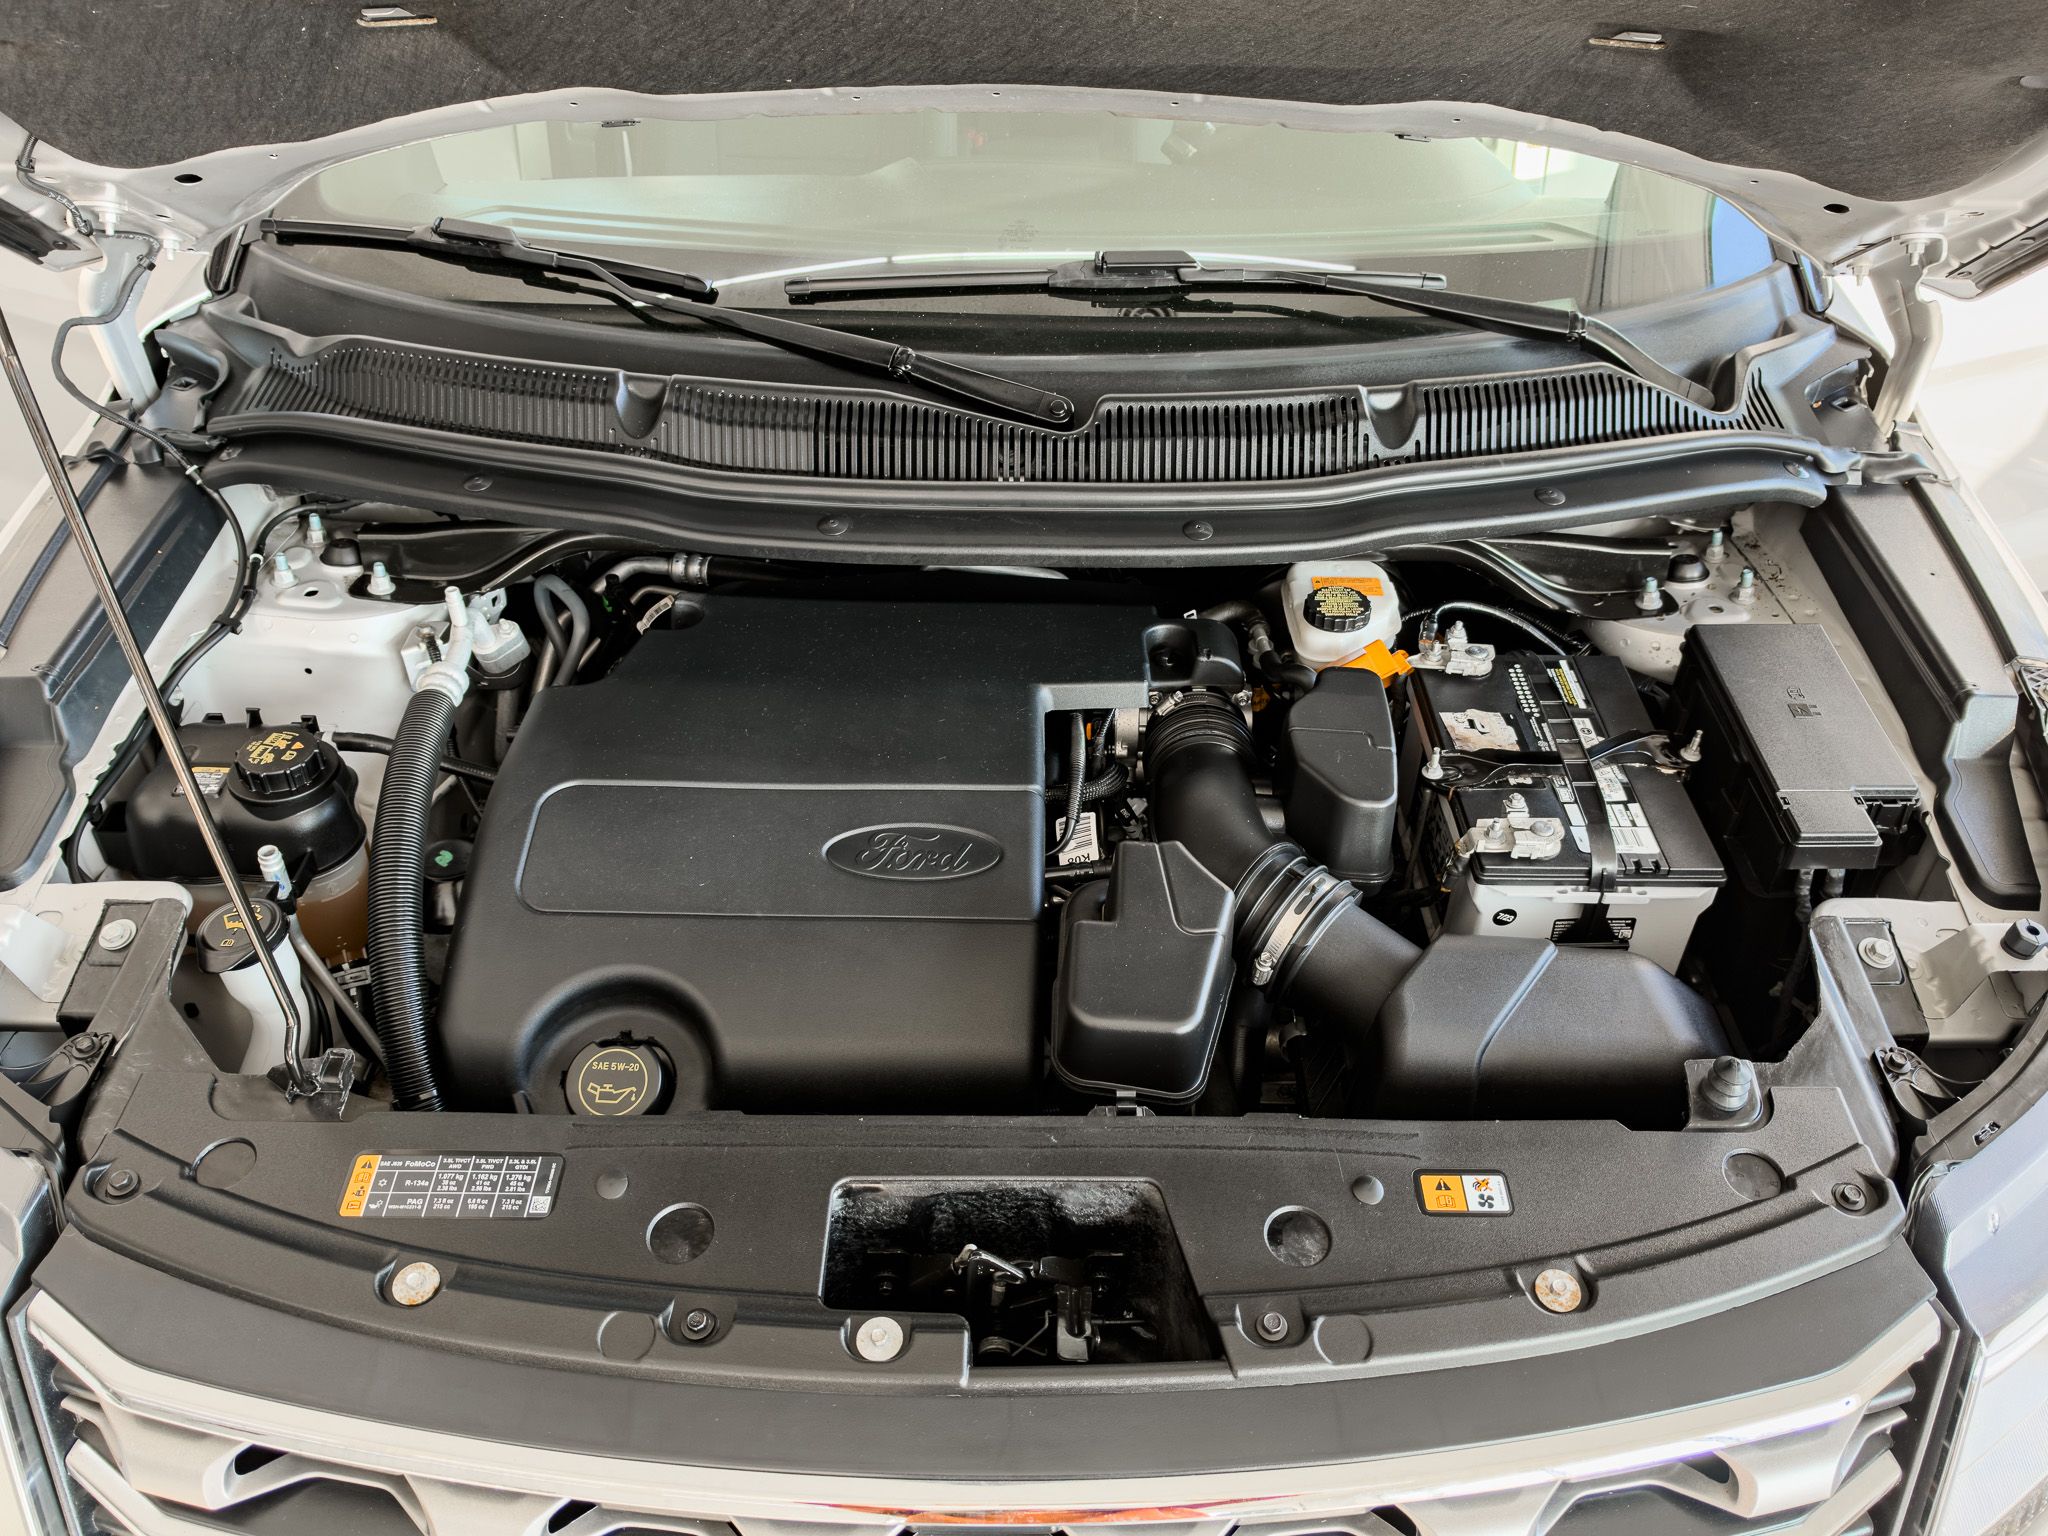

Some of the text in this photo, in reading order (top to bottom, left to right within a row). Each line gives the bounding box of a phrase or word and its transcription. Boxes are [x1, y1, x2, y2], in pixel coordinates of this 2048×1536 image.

[856, 831, 975, 873] Ford
[592, 1062, 640, 1071] SAE 5W-20
[455, 1173, 464, 1181] kg
[490, 1173, 498, 1181] kg
